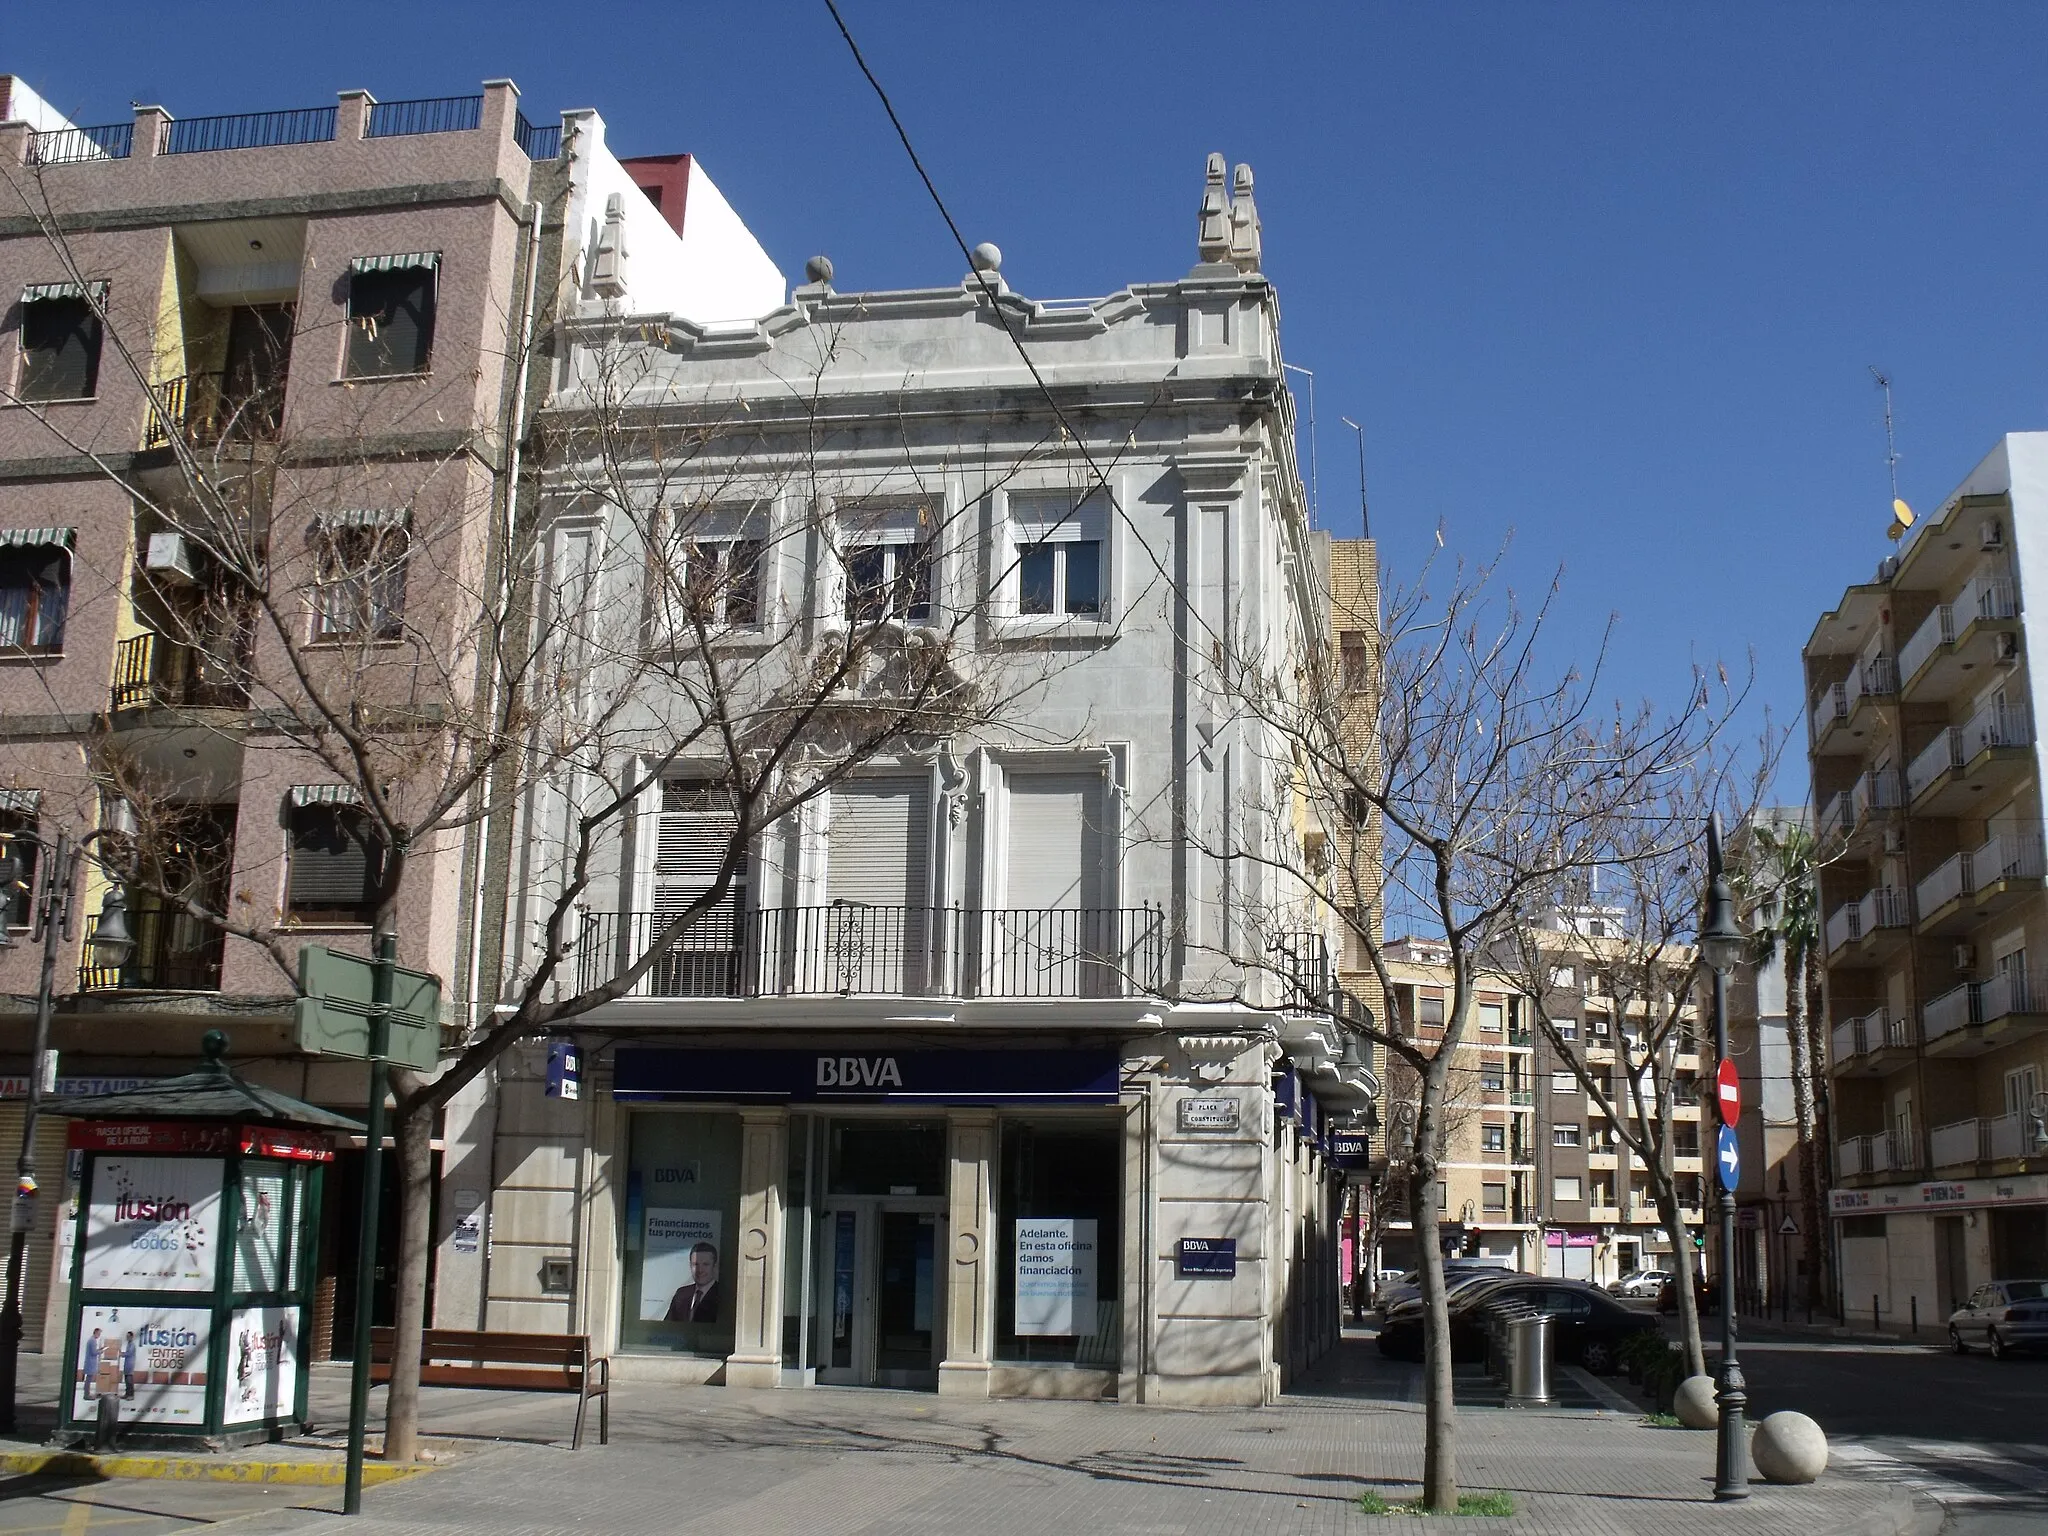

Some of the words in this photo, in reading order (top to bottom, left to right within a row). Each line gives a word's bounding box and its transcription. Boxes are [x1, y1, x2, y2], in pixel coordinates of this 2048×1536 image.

[817, 1058, 902, 1086] BBVA
[0, 1079, 26, 1094] AL
[106, 1136, 117, 1145] DE
[118, 1136, 129, 1145] LA
[1334, 1142, 1363, 1152] BBVA
[655, 1168, 695, 1183] BBVA
[115, 1192, 190, 1222] ilusión
[649, 1218, 710, 1229] Financiamos
[648, 1228, 664, 1237] tus
[665, 1229, 714, 1240] proyectos
[1020, 1229, 1069, 1238] Adelante.
[131, 1235, 179, 1250] todos
[1020, 1241, 1033, 1250] En
[1034, 1241, 1056, 1250] esta
[1057, 1241, 1092, 1251] oficina
[1183, 1241, 1209, 1250] BBVA
[1020, 1254, 1054, 1263] damos
[1020, 1265, 1082, 1275] financiación
[139, 1323, 197, 1347] ilusión
[152, 1348, 185, 1358] ENTRE
[148, 1358, 184, 1369] TODOS
